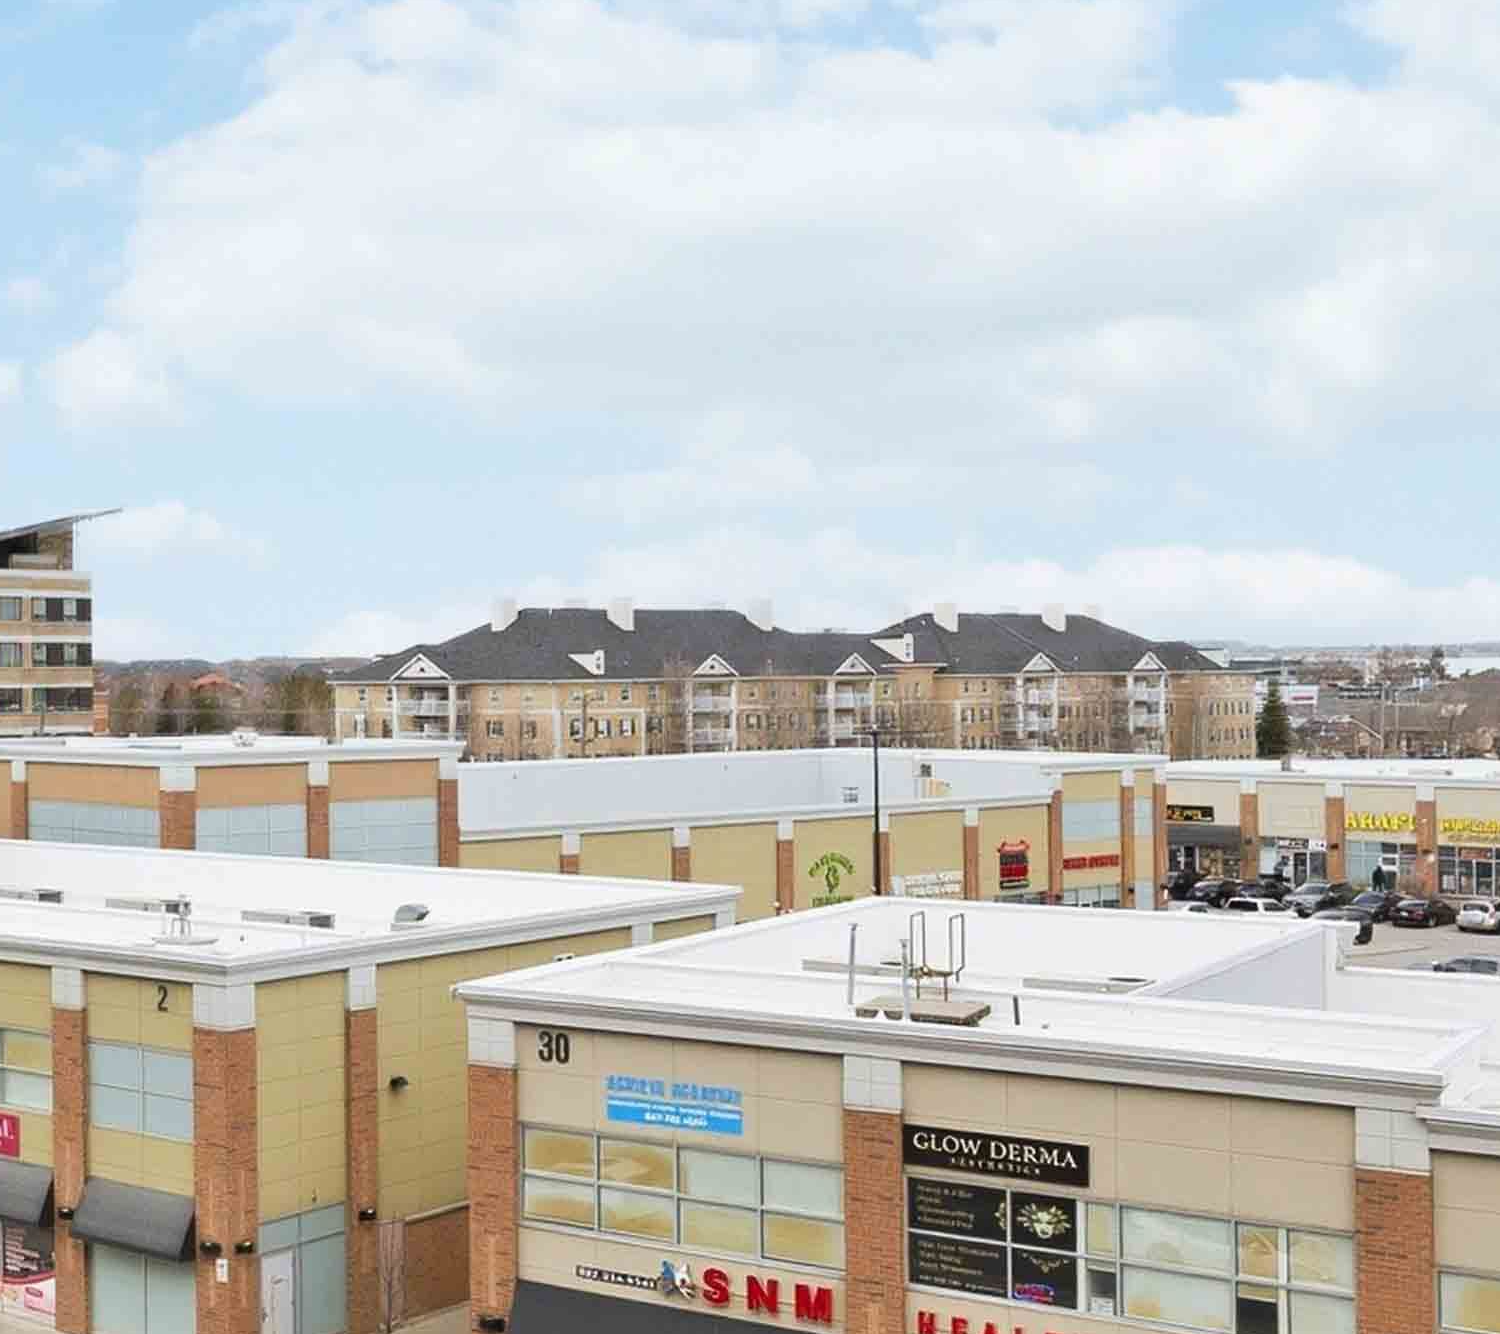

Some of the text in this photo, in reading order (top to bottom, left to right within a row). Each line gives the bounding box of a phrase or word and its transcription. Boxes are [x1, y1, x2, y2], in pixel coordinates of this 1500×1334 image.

[157, 984, 169, 1013] 2
[538, 1031, 570, 1064] 30
[913, 1132, 1077, 1168] GLOW DERMA
[702, 1268, 833, 1323] SNM
